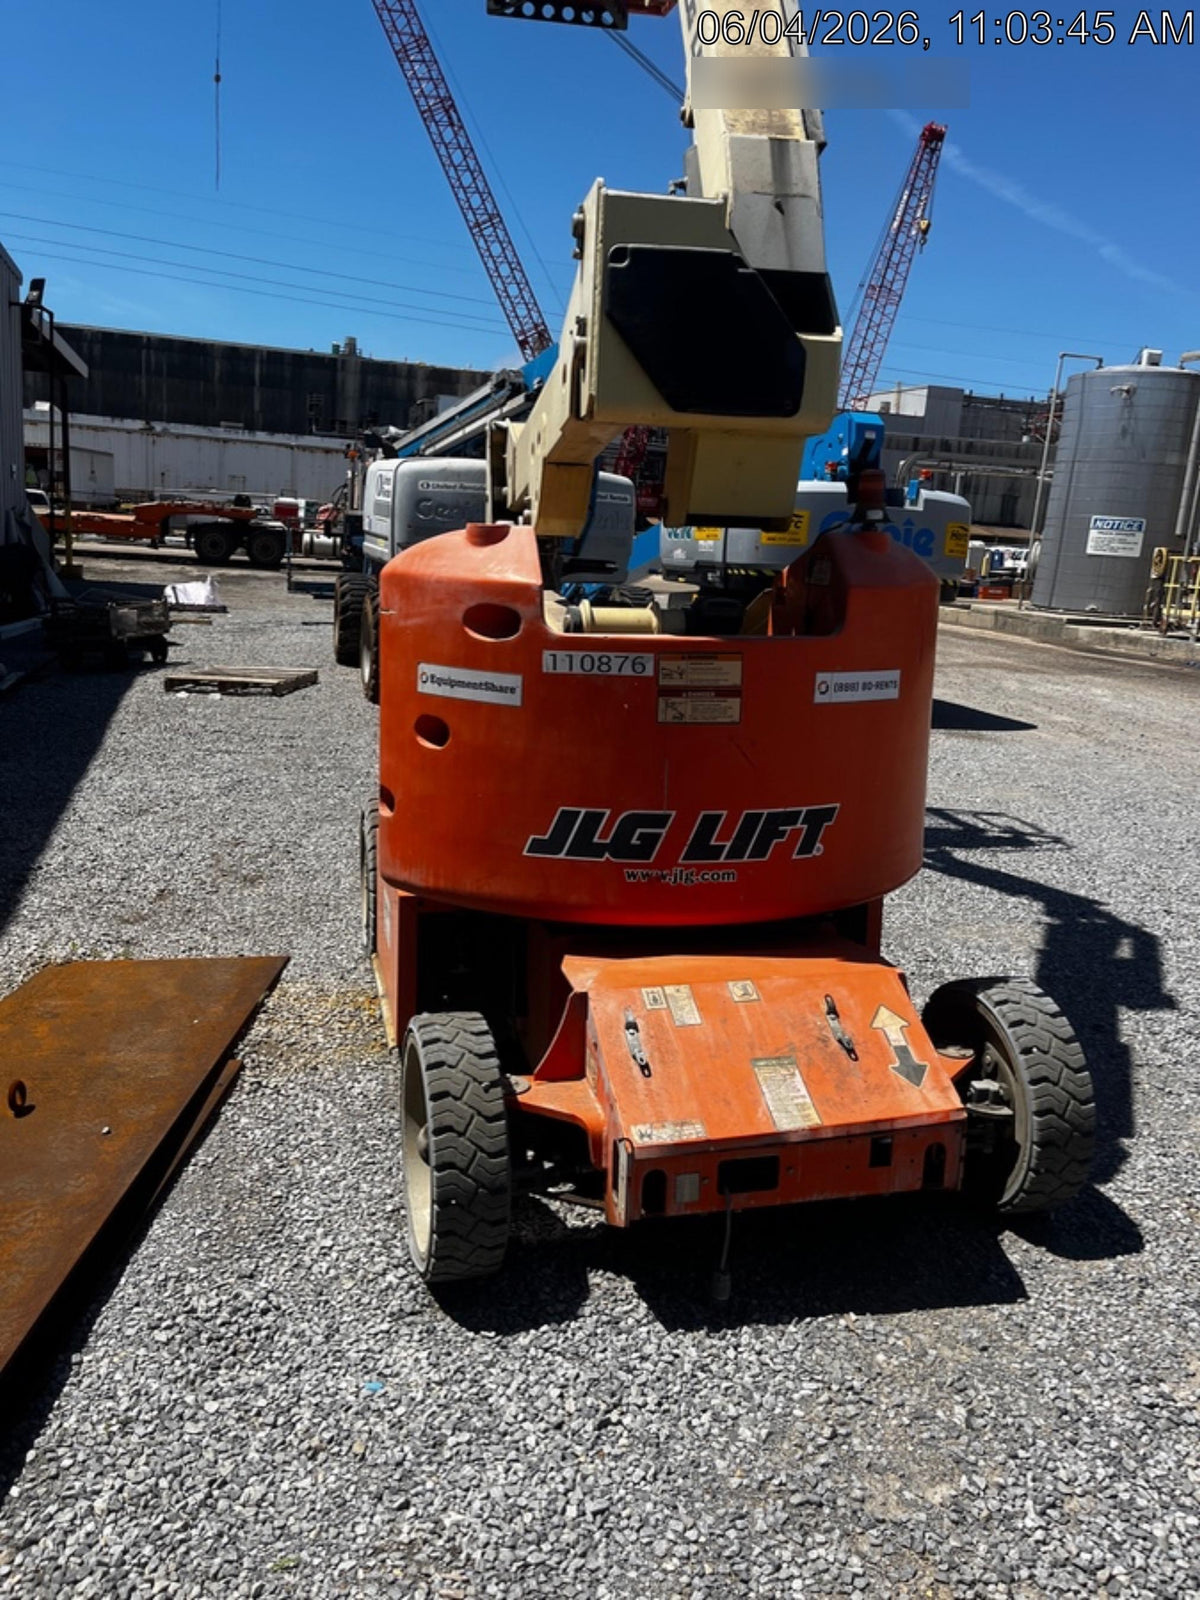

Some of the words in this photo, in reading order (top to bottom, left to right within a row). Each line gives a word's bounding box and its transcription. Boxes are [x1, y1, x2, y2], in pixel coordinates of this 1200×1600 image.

[1094, 519, 1141, 531] NOTICE
[549, 653, 647, 674] 110876
[430, 673, 517, 695] EquipmentShare
[522, 806, 677, 863] JLG
[679, 803, 841, 864] LIFT
